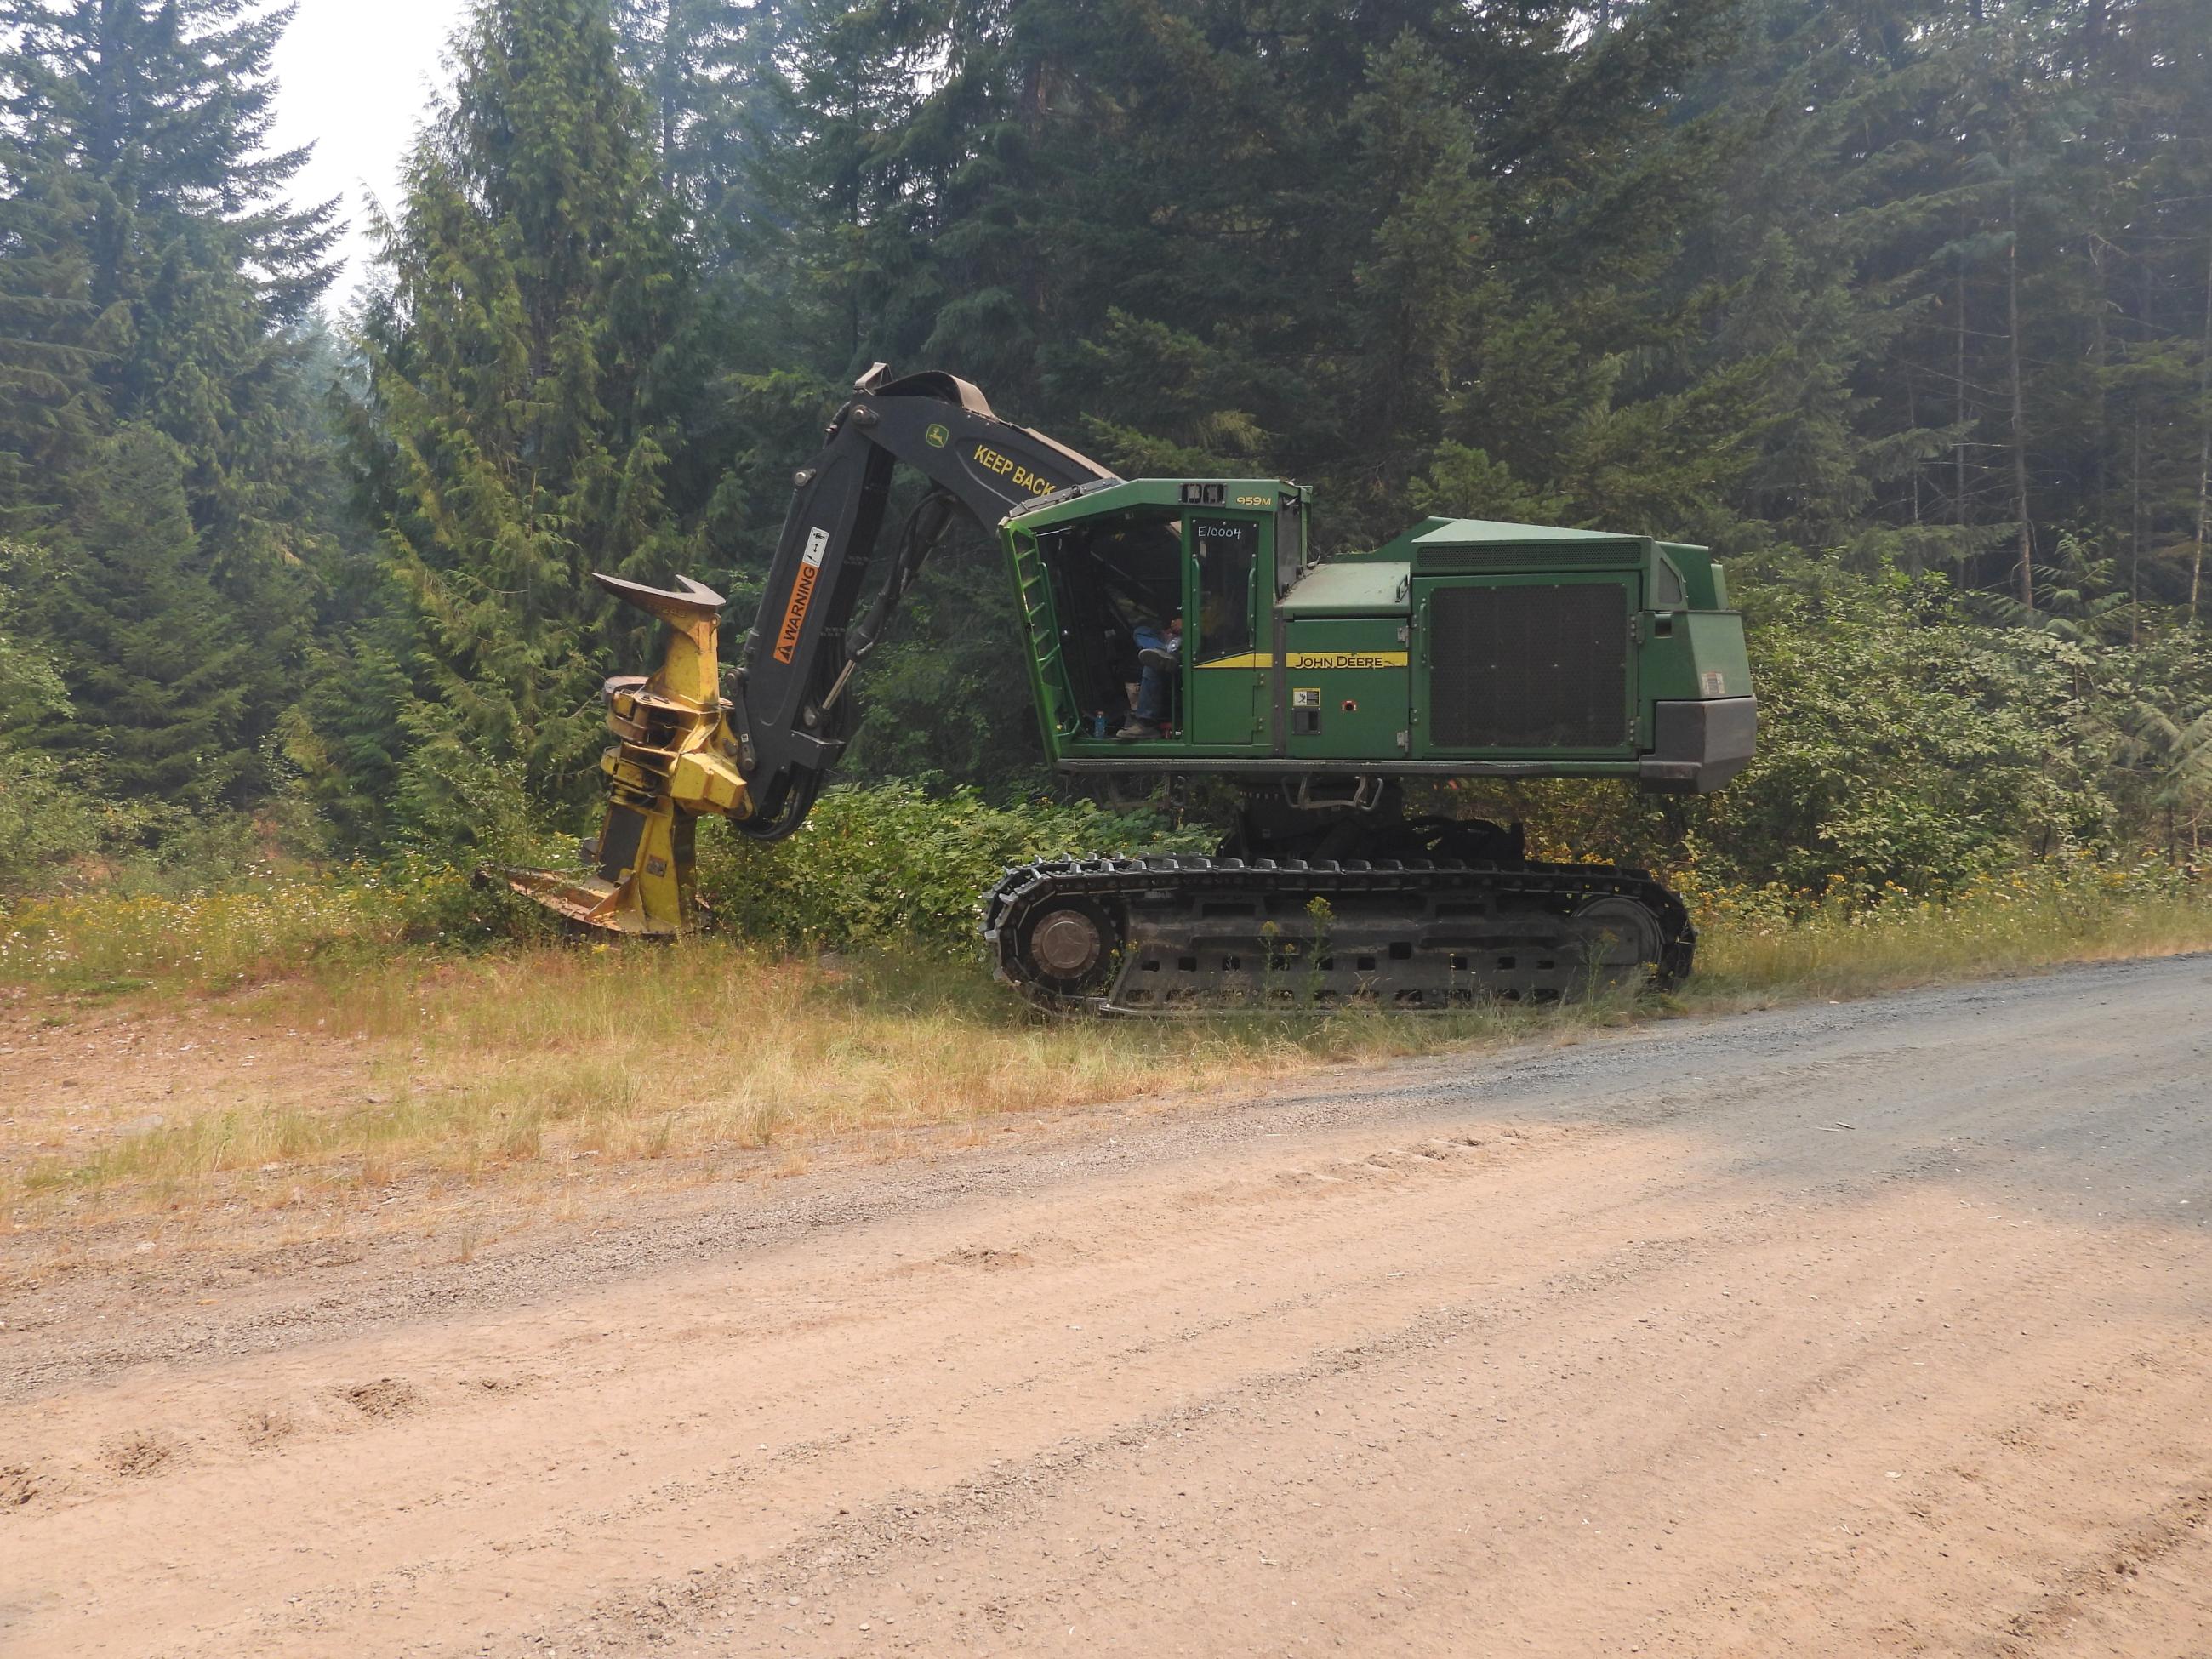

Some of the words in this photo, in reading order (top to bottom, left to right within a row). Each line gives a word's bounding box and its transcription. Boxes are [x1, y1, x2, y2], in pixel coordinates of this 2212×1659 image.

[973, 444, 1014, 475] KEEP
[1012, 465, 1057, 498] BACK
[1236, 496, 1272, 505] 959M
[1198, 526, 1242, 540] E10004
[783, 566, 816, 641] WARNING
[1295, 656, 1333, 668] JOHN
[1337, 656, 1382, 668] DEERE
